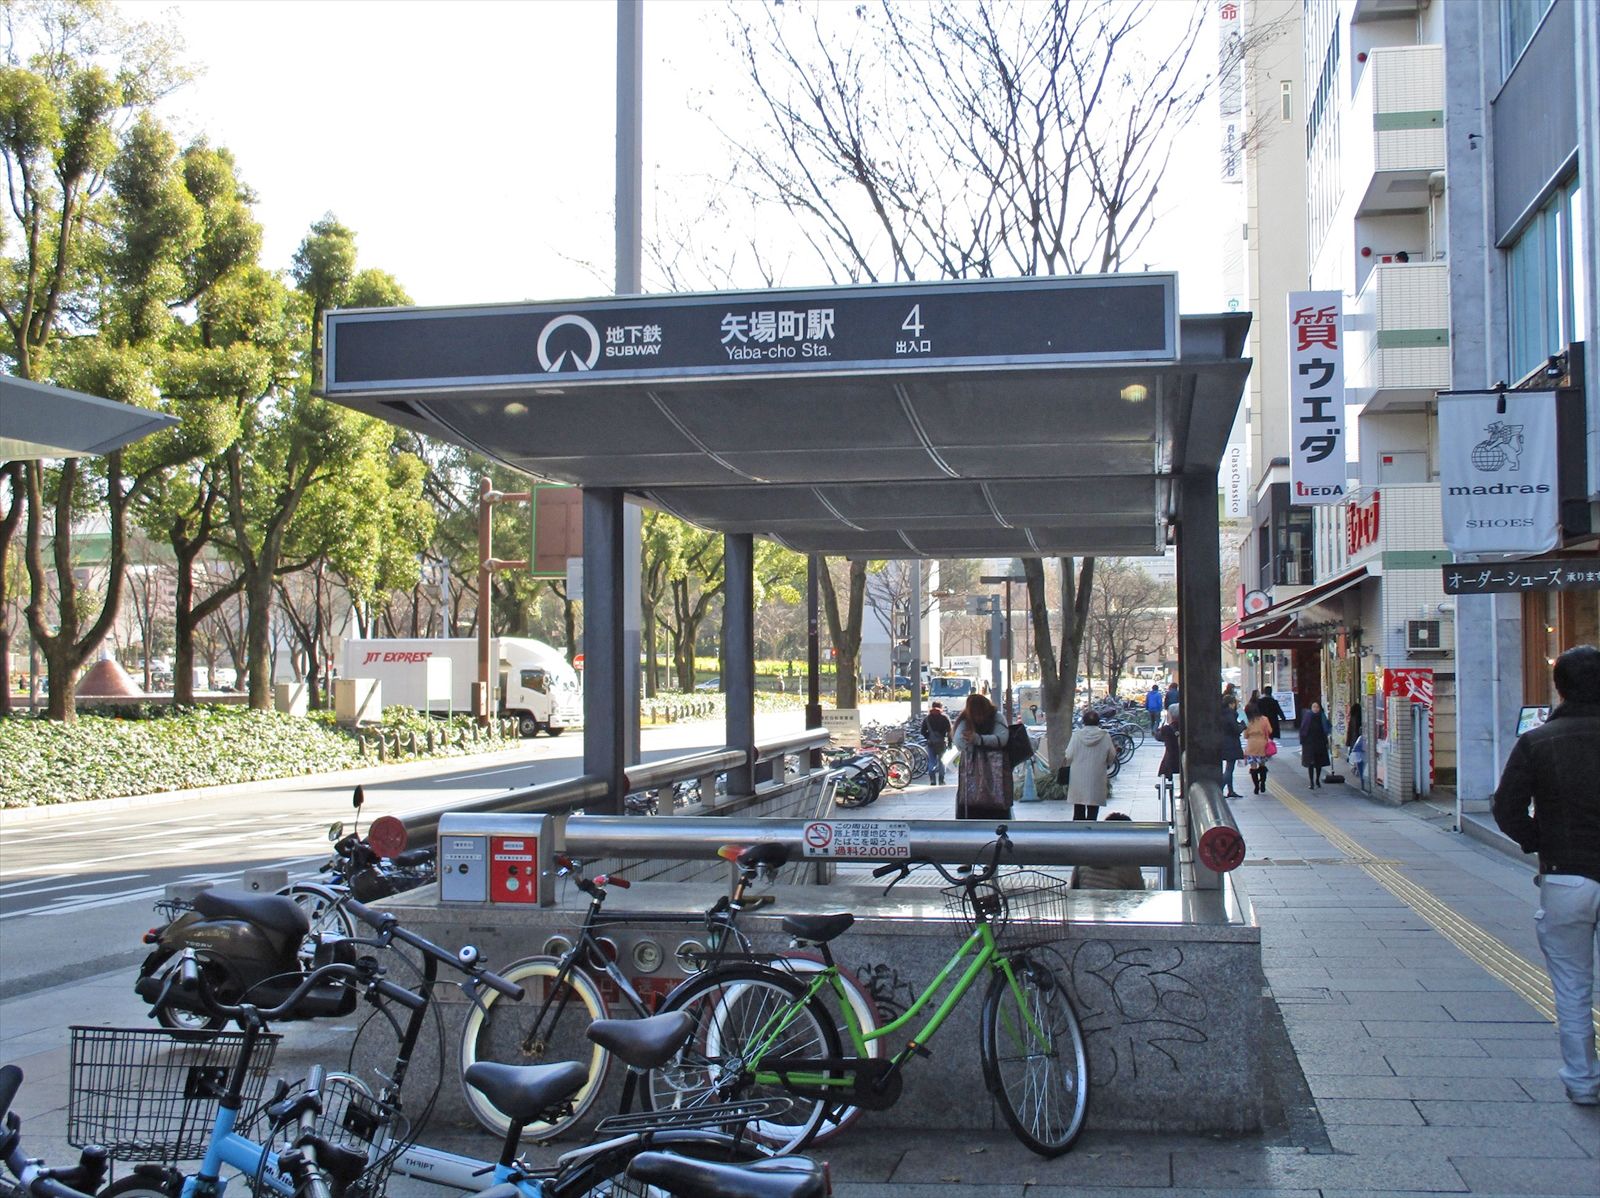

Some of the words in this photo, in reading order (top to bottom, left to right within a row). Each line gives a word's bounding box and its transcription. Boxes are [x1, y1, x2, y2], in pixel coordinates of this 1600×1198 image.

[720, 308, 835, 344] 矢場町駅
[901, 303, 925, 337] 4
[605, 324, 662, 344] 地下鉄
[605, 344, 662, 357] SUBWAY
[725, 344, 796, 360] Yaba-cho
[801, 342, 832, 357] Sta.
[895, 340, 931, 354] 出入口
[1448, 482, 1551, 496] madras
[1465, 518, 1535, 529] SHOES
[1449, 567, 1563, 589] オーダーシューズ
[362, 652, 382, 665] JIT
